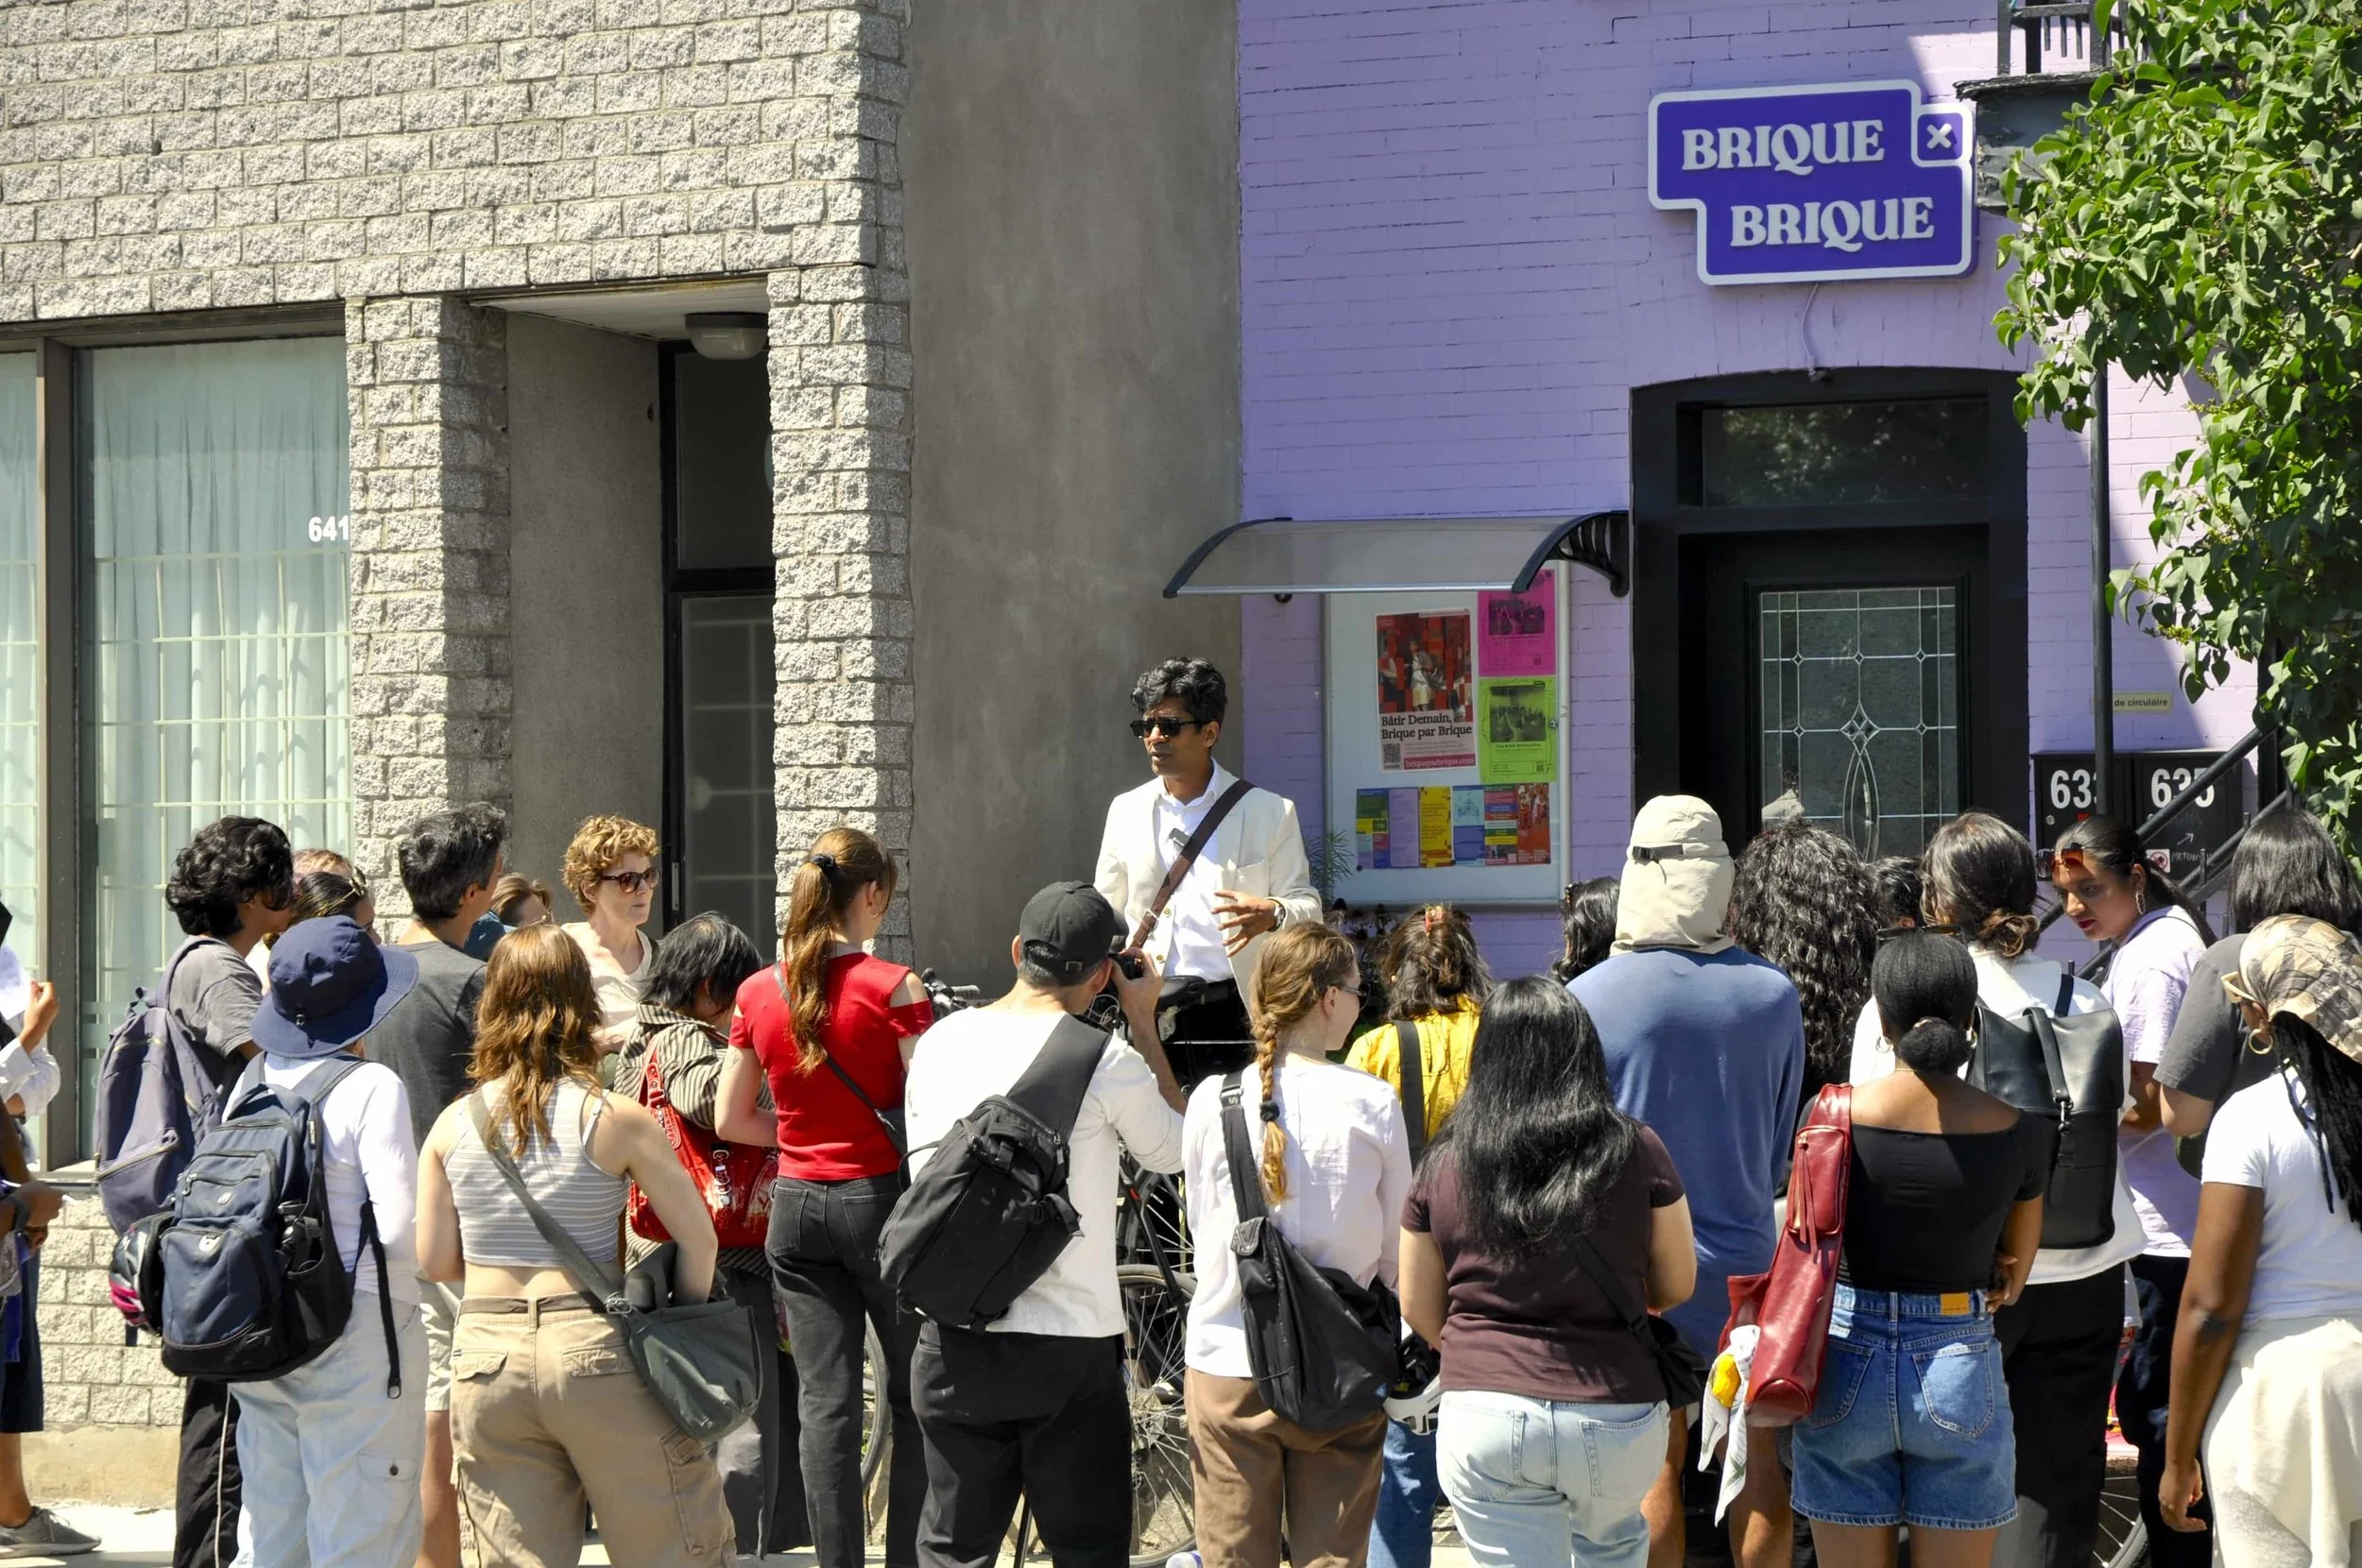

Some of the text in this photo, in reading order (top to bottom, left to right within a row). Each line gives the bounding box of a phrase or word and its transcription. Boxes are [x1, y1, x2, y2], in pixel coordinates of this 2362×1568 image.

[1682, 119, 1885, 176] BRIQUE
[1730, 196, 1935, 253] BRIQUE
[308, 516, 350, 542] 641
[2128, 698, 2168, 707] circulaire
[1381, 713, 1452, 726] Bâtir Demain,
[1381, 725, 1473, 741] Brique par Brique
[2050, 769, 2097, 809] 63
